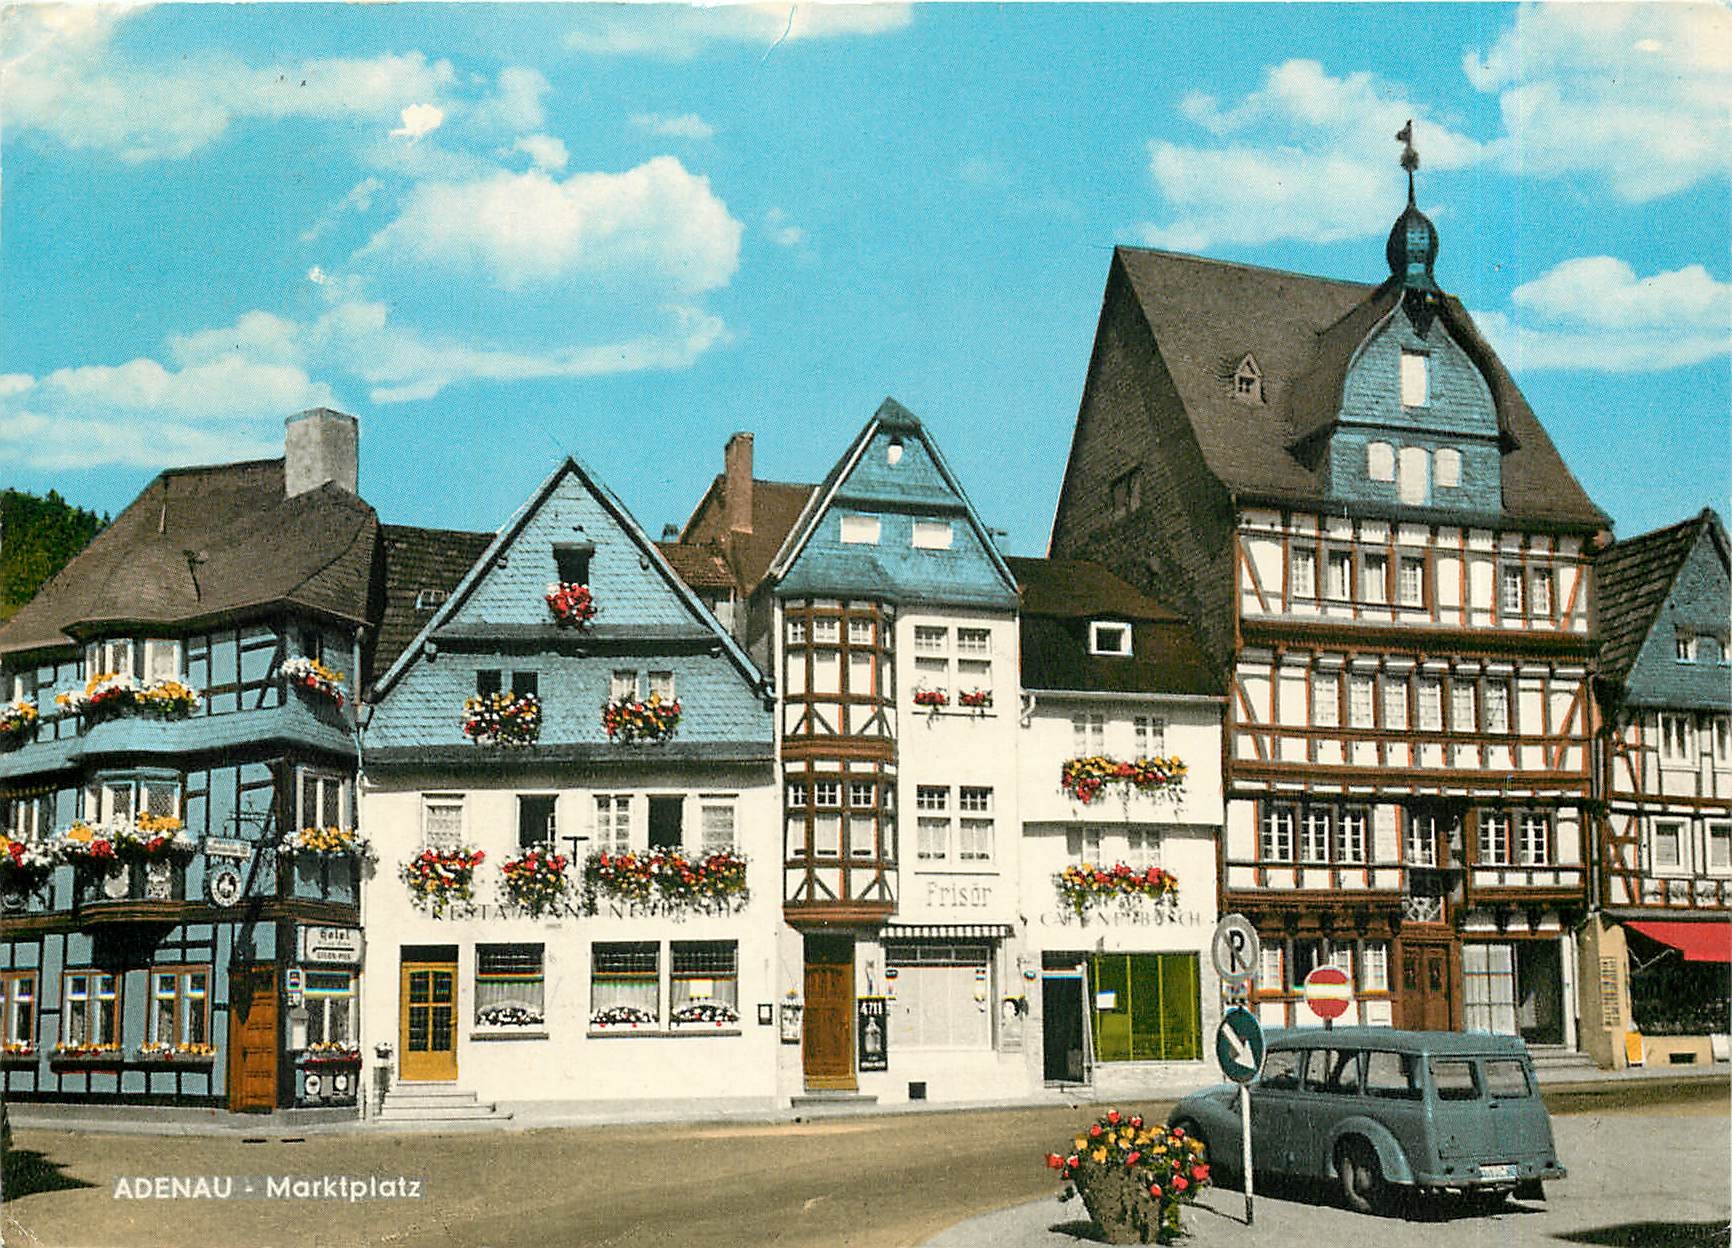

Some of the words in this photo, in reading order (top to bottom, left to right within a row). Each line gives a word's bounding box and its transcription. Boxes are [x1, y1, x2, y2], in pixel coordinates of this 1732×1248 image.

[926, 881, 992, 907] Frisör
[431, 902, 598, 921] RESTAUAN
[1229, 930, 1245, 973] P
[860, 1002, 882, 1015] 4711
